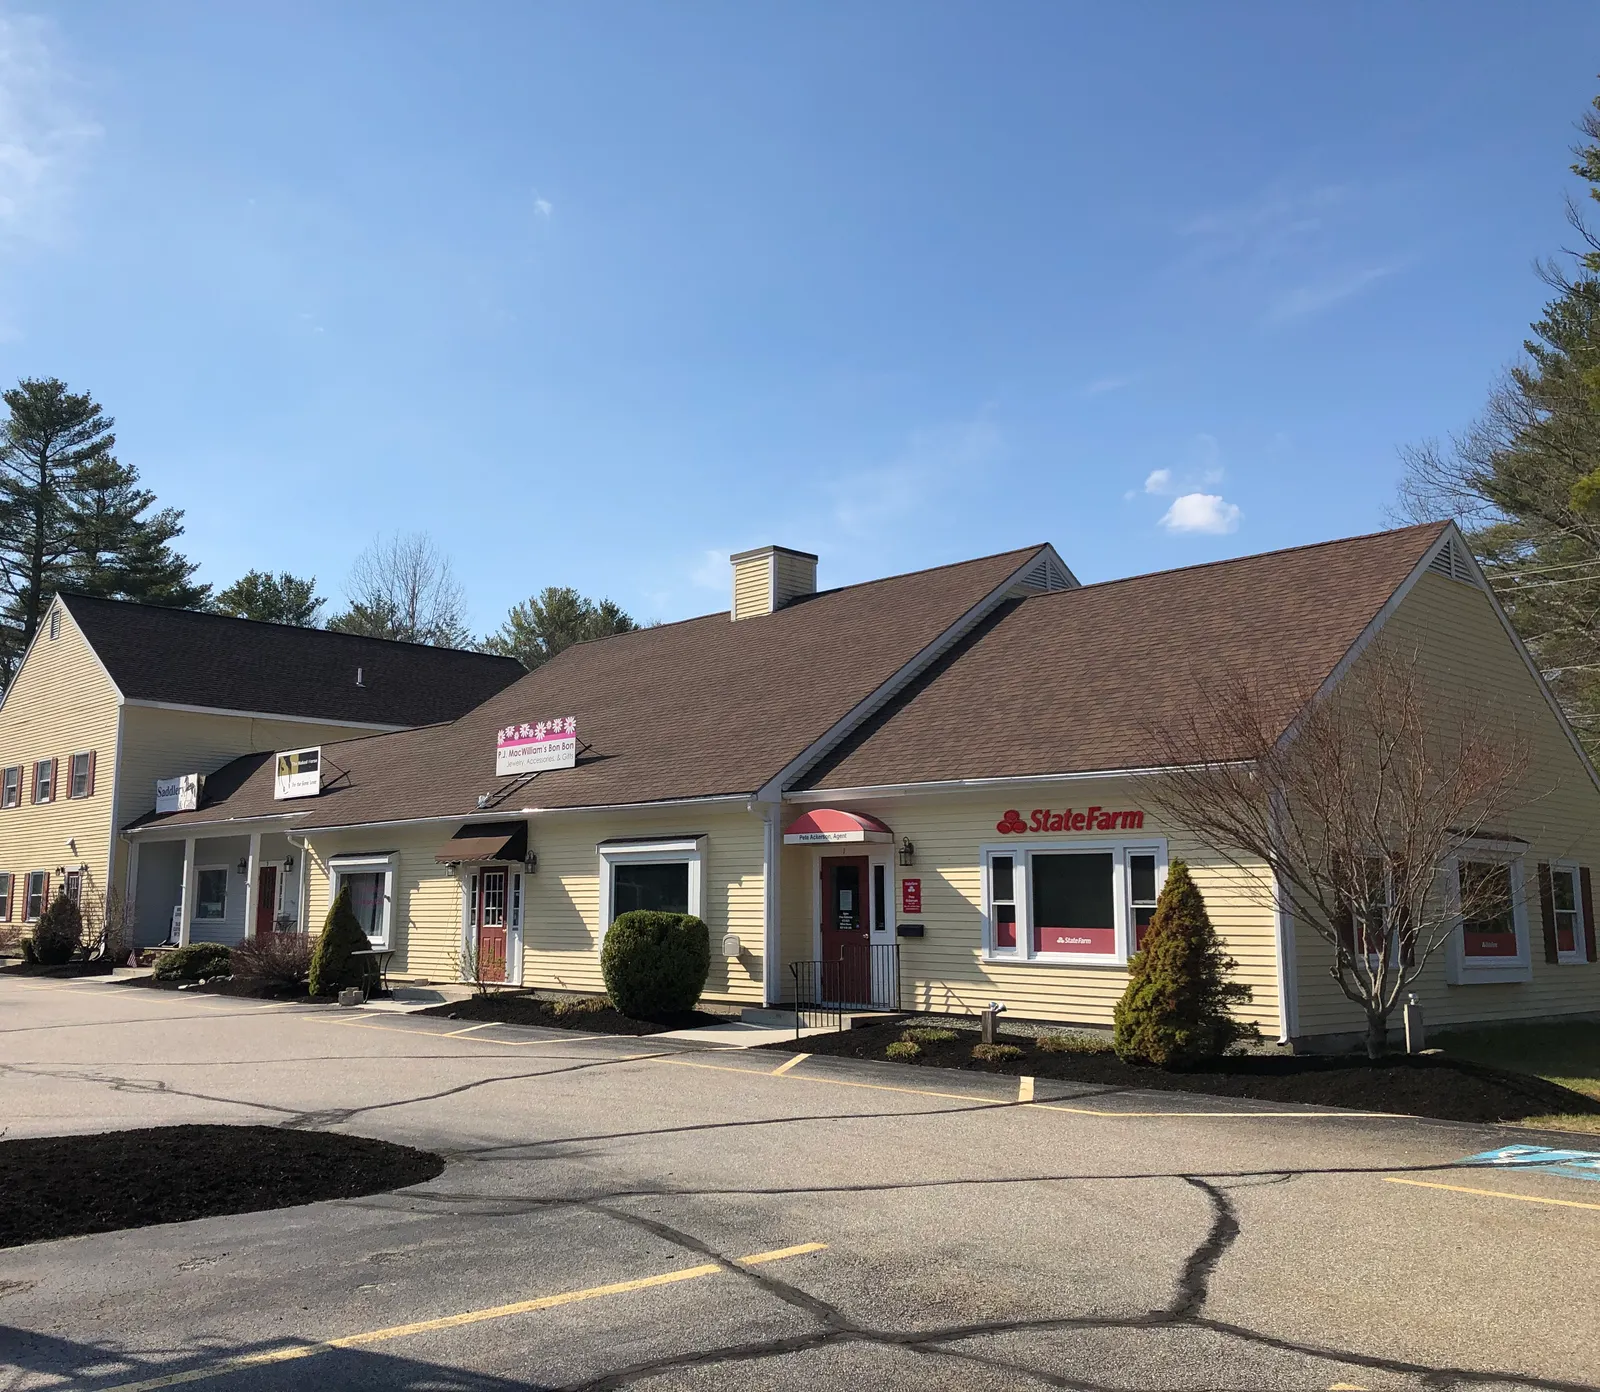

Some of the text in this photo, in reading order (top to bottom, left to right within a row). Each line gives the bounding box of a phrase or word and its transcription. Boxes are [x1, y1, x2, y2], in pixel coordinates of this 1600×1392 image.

[509, 745, 547, 758] MacWilliam's
[548, 743, 561, 753] Bon
[562, 742, 574, 751] Bon
[1029, 806, 1144, 833] StateFarm
